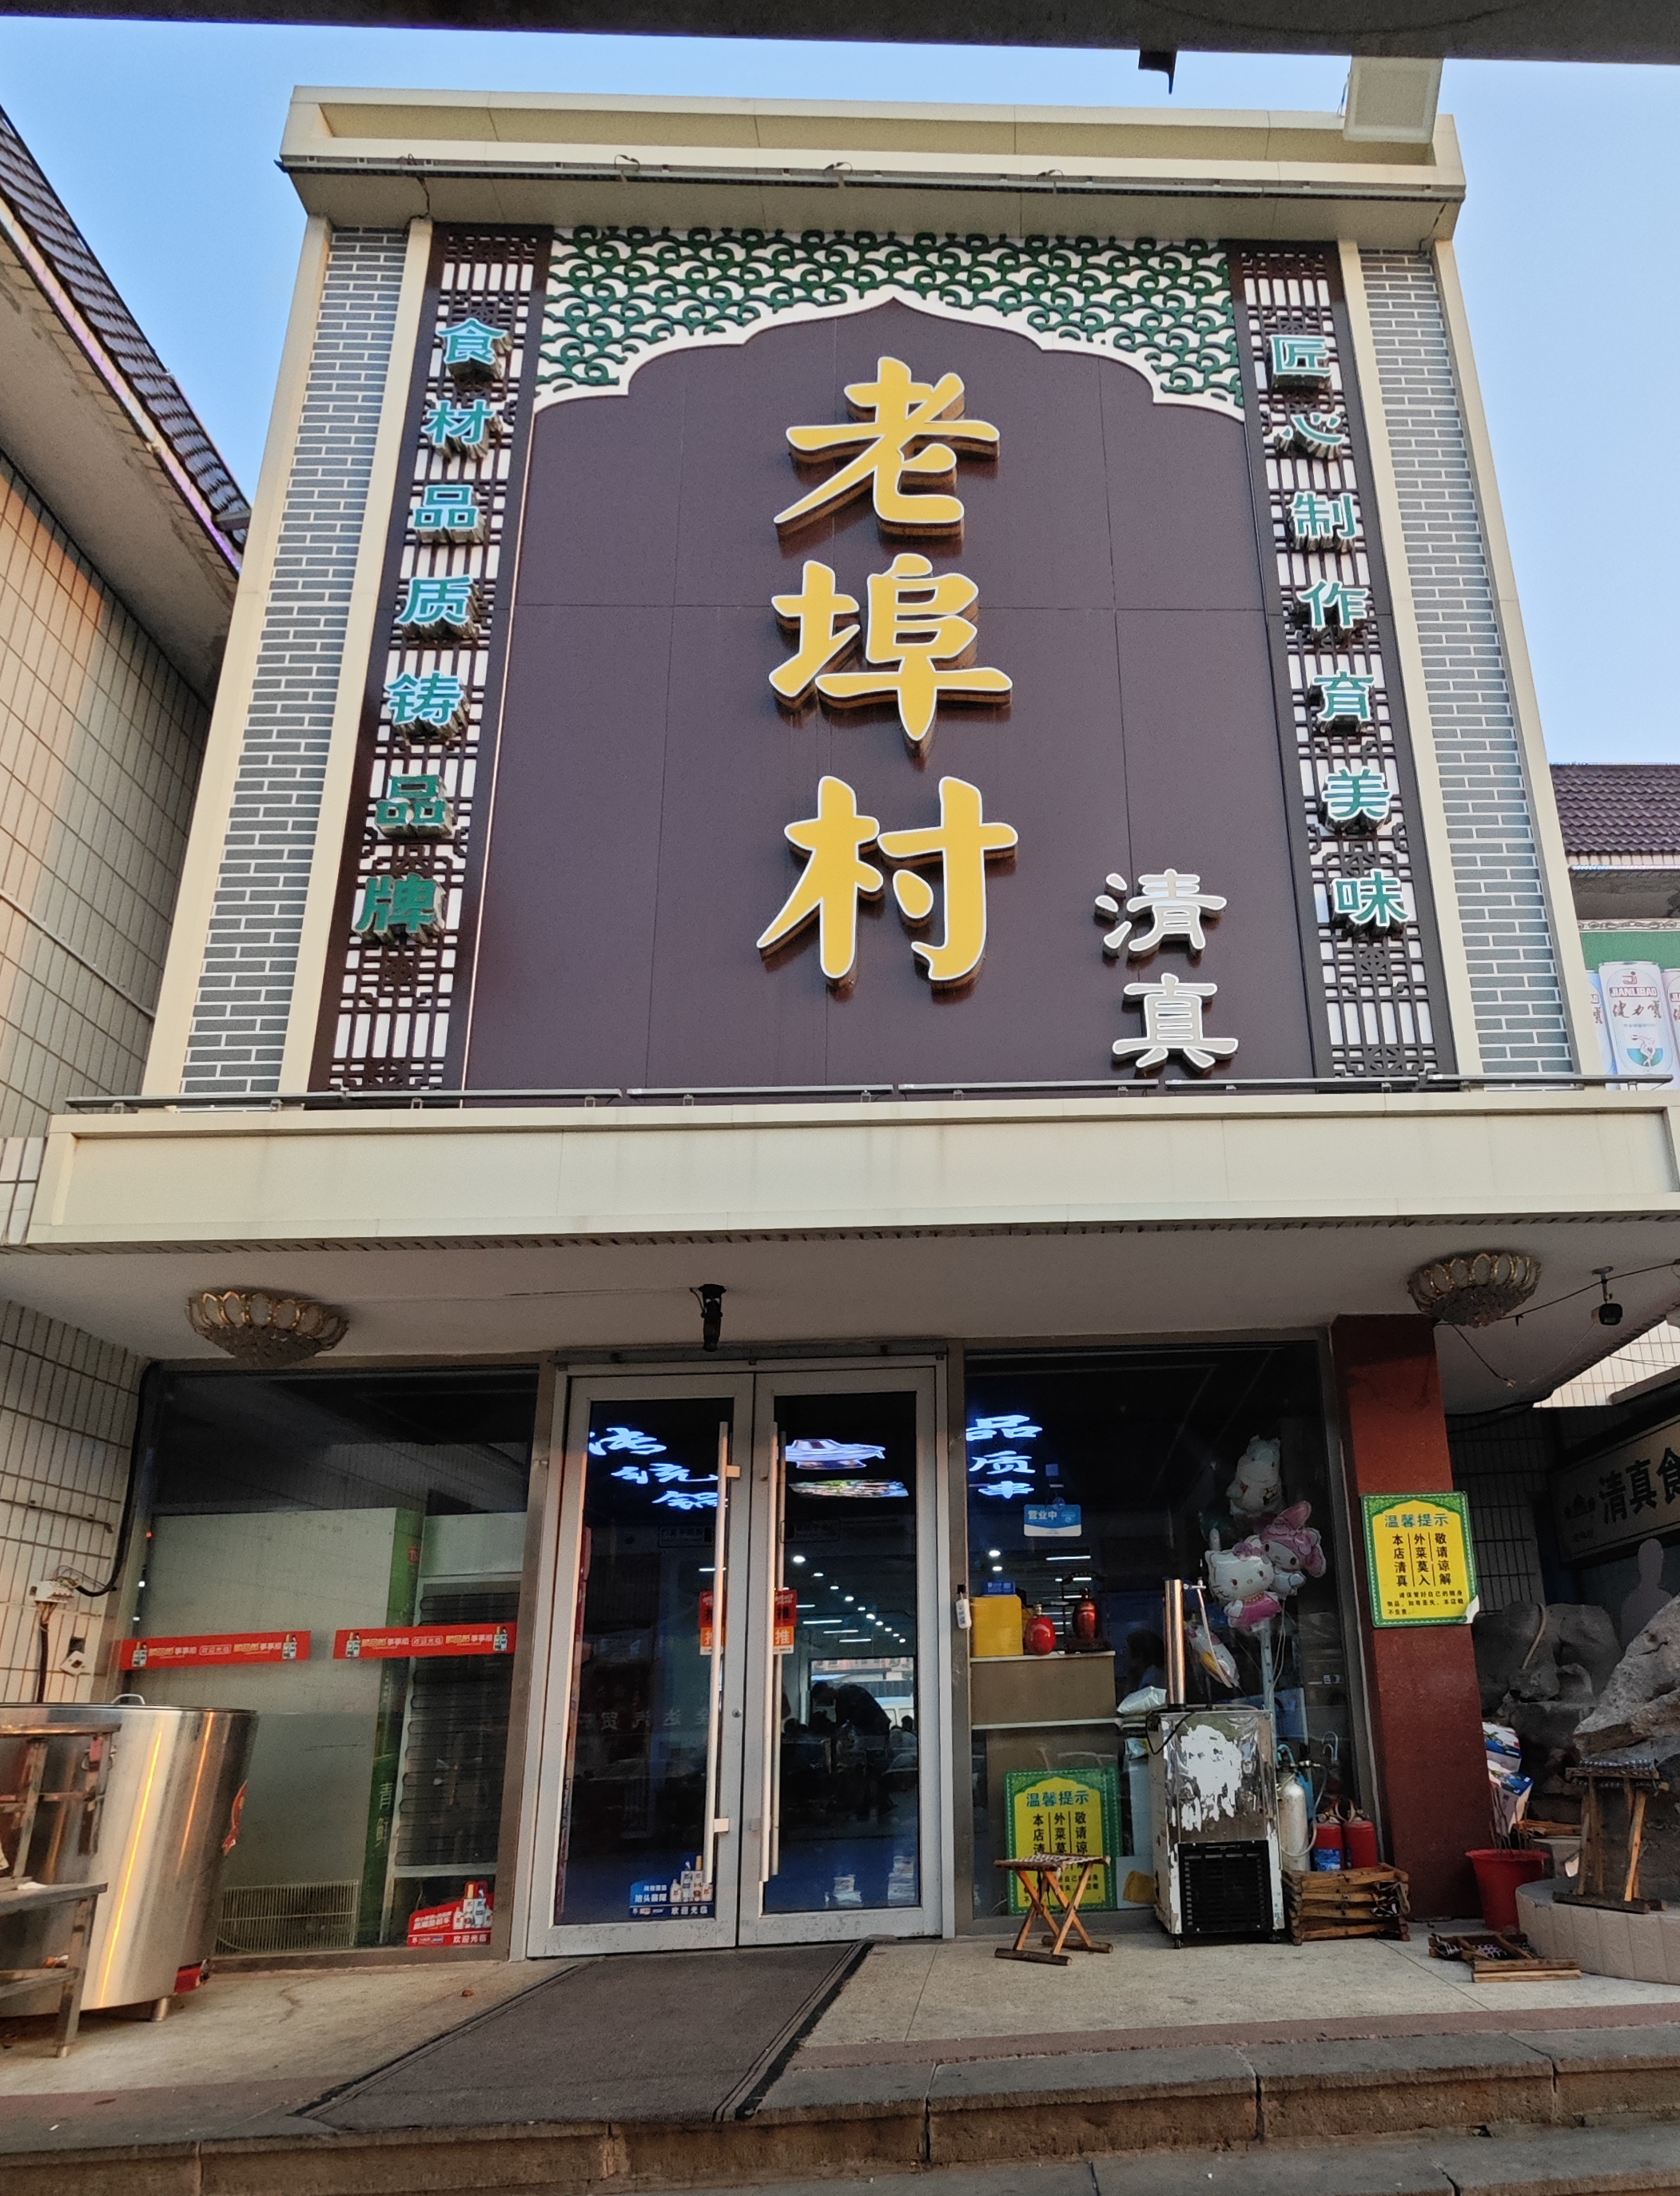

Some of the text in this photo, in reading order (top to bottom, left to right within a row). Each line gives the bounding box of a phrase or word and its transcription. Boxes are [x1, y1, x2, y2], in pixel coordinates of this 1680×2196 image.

[353, 317, 507, 933] 食材品质铸品牌
[1268, 334, 1411, 927] 匠心制作育美味
[756, 356, 1019, 983] 老埠村
[1095, 869, 1239, 1069] 清真
[1610, 987, 1657, 997] JIANLIBAO
[965, 1414, 1043, 1499] 品质串
[1028, 1510, 1057, 1520] 营业中
[1384, 1514, 1449, 1528] 温馨提示
[1391, 1534, 1407, 1587] 本店清真
[1414, 1533, 1430, 1586] 外菜莫入
[1434, 1532, 1451, 1585] 敬请谅解
[774, 1629, 790, 1645] 推
[1026, 1790, 1089, 1807] 温馨提示
[1033, 1813, 1045, 1856] 本店清
[1054, 1812, 1067, 1854] 外菜莫
[1075, 1812, 1088, 1855] 敬请谅
